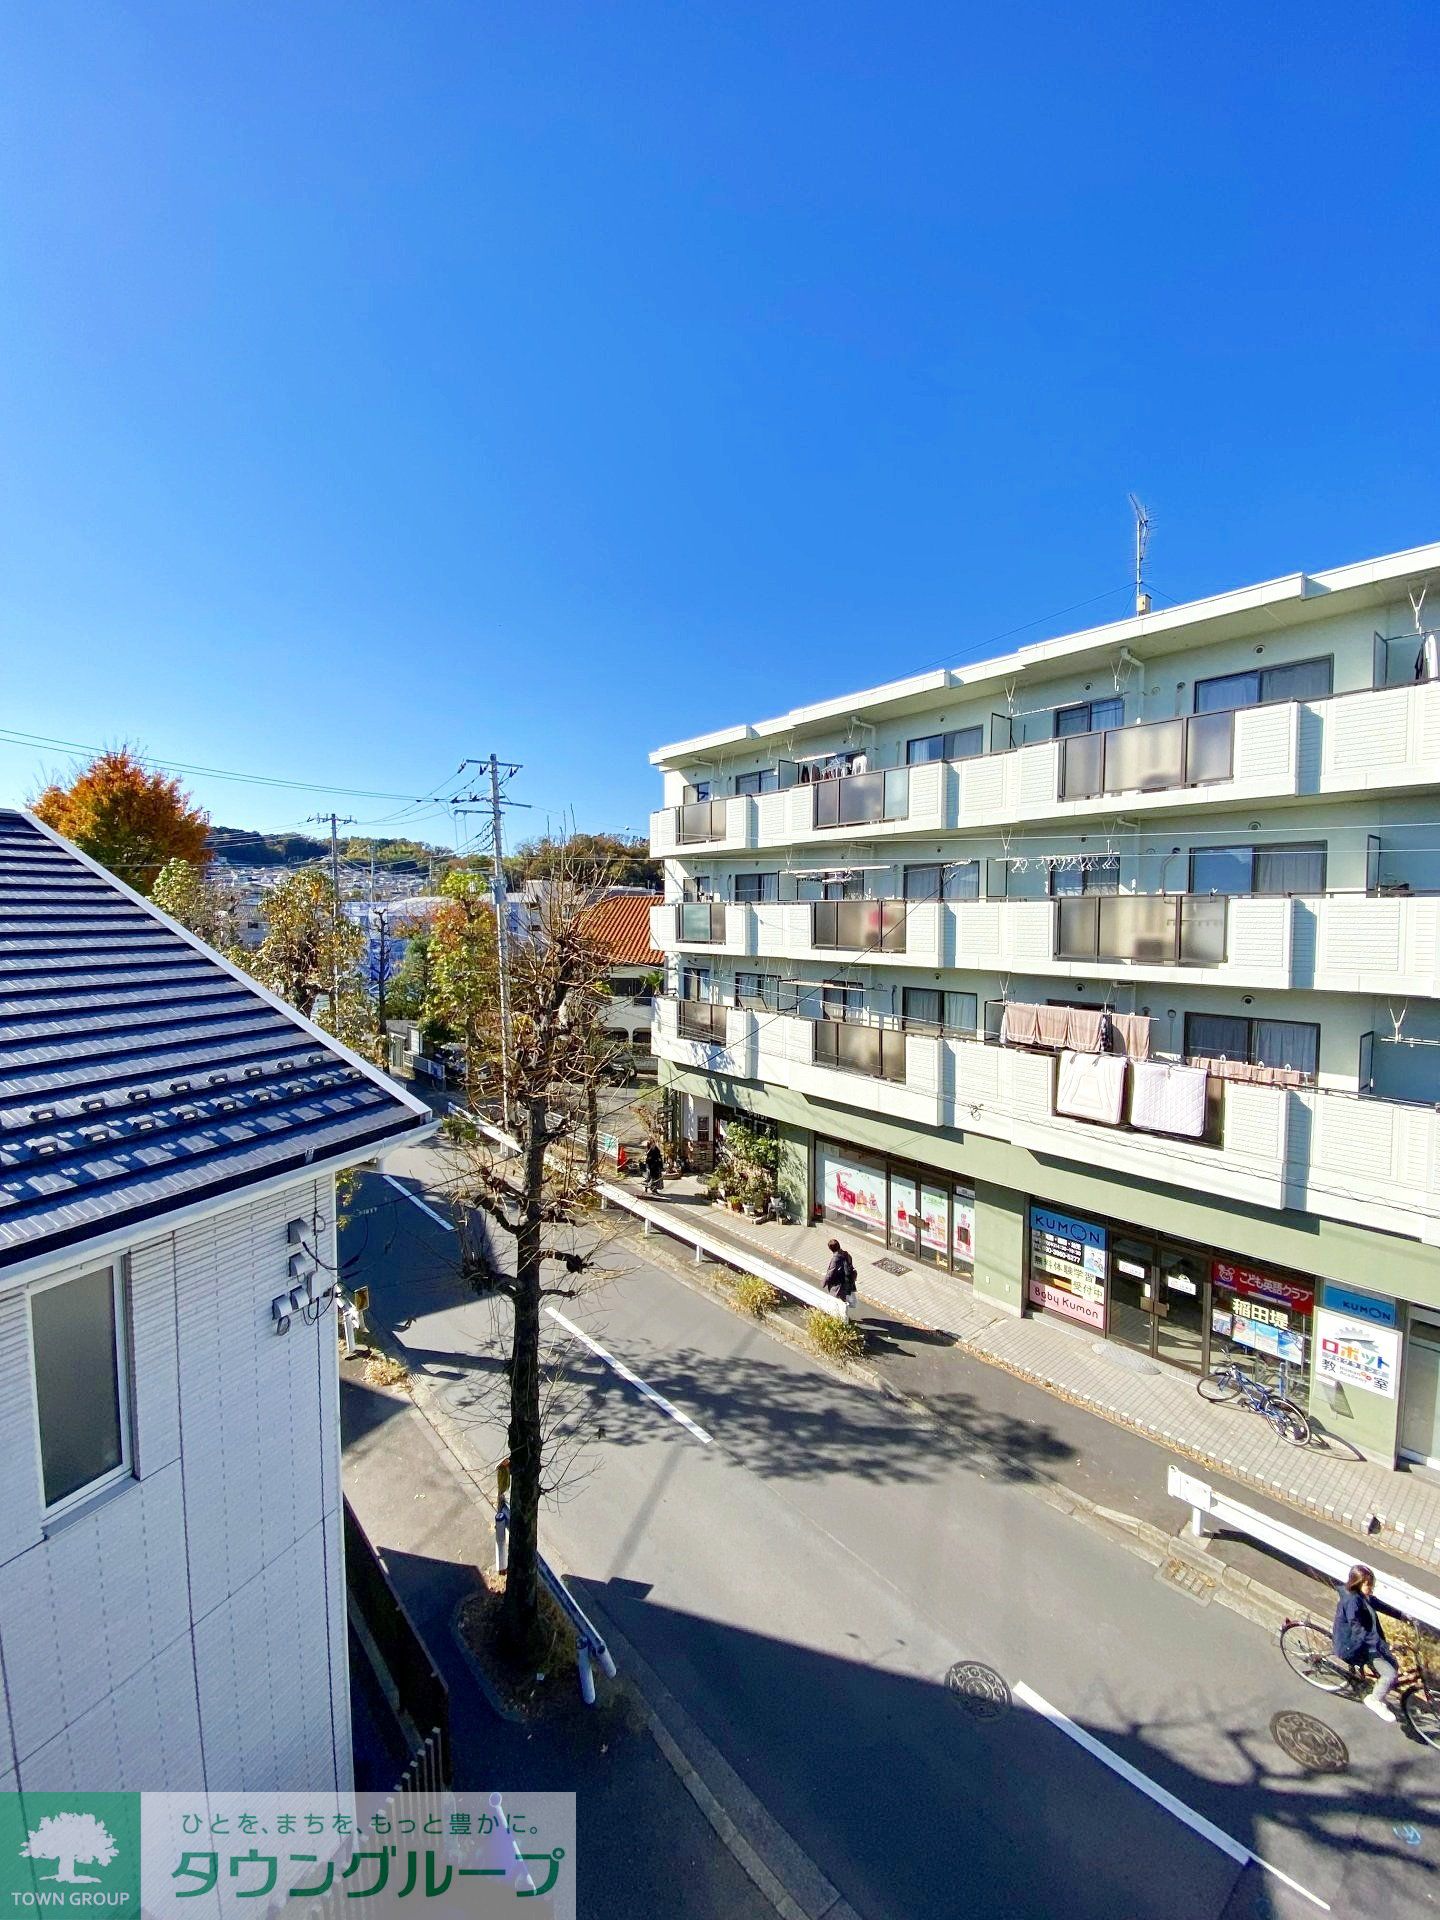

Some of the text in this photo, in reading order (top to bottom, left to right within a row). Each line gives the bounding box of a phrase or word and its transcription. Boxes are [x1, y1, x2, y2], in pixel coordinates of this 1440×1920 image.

[1035, 1214, 1100, 1244] KUMON
[1239, 1272, 1313, 1302] こども英語クラブ
[1034, 1286, 1099, 1319] Baby Kumon
[1232, 1298, 1289, 1330] 稲田堤
[1342, 1301, 1391, 1320] KUMON
[1322, 1338, 1390, 1369] ロボット
